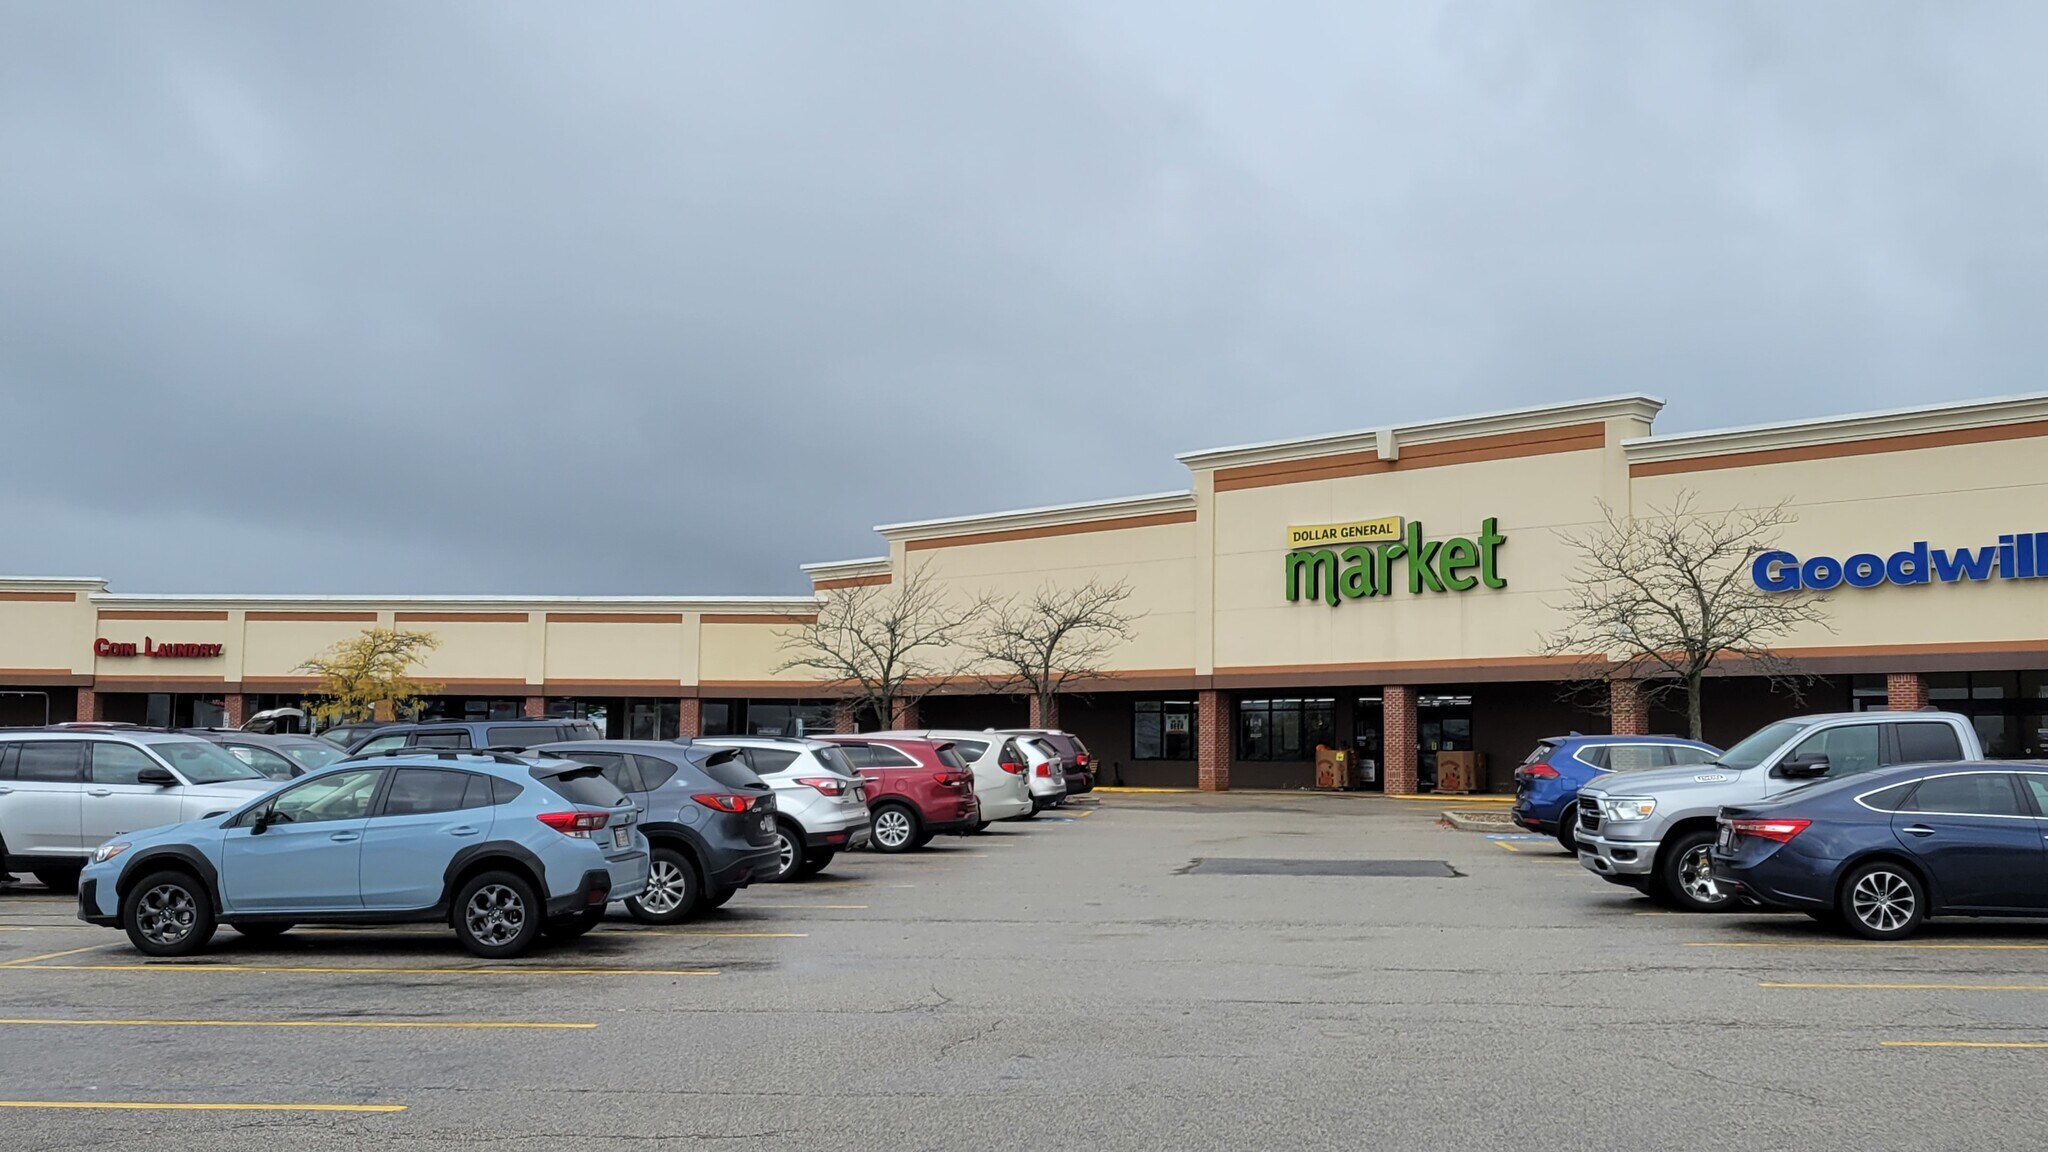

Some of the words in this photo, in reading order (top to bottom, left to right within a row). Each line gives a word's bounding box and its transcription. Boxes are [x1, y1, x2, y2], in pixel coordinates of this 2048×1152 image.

[1293, 528, 1337, 542] DOLLAR
[1340, 523, 1393, 538] GENERAL
[1285, 517, 1507, 607] market
[1752, 532, 2048, 593] Goodwill
[94, 638, 136, 657] COIN
[145, 636, 222, 657] LAUNDRY
